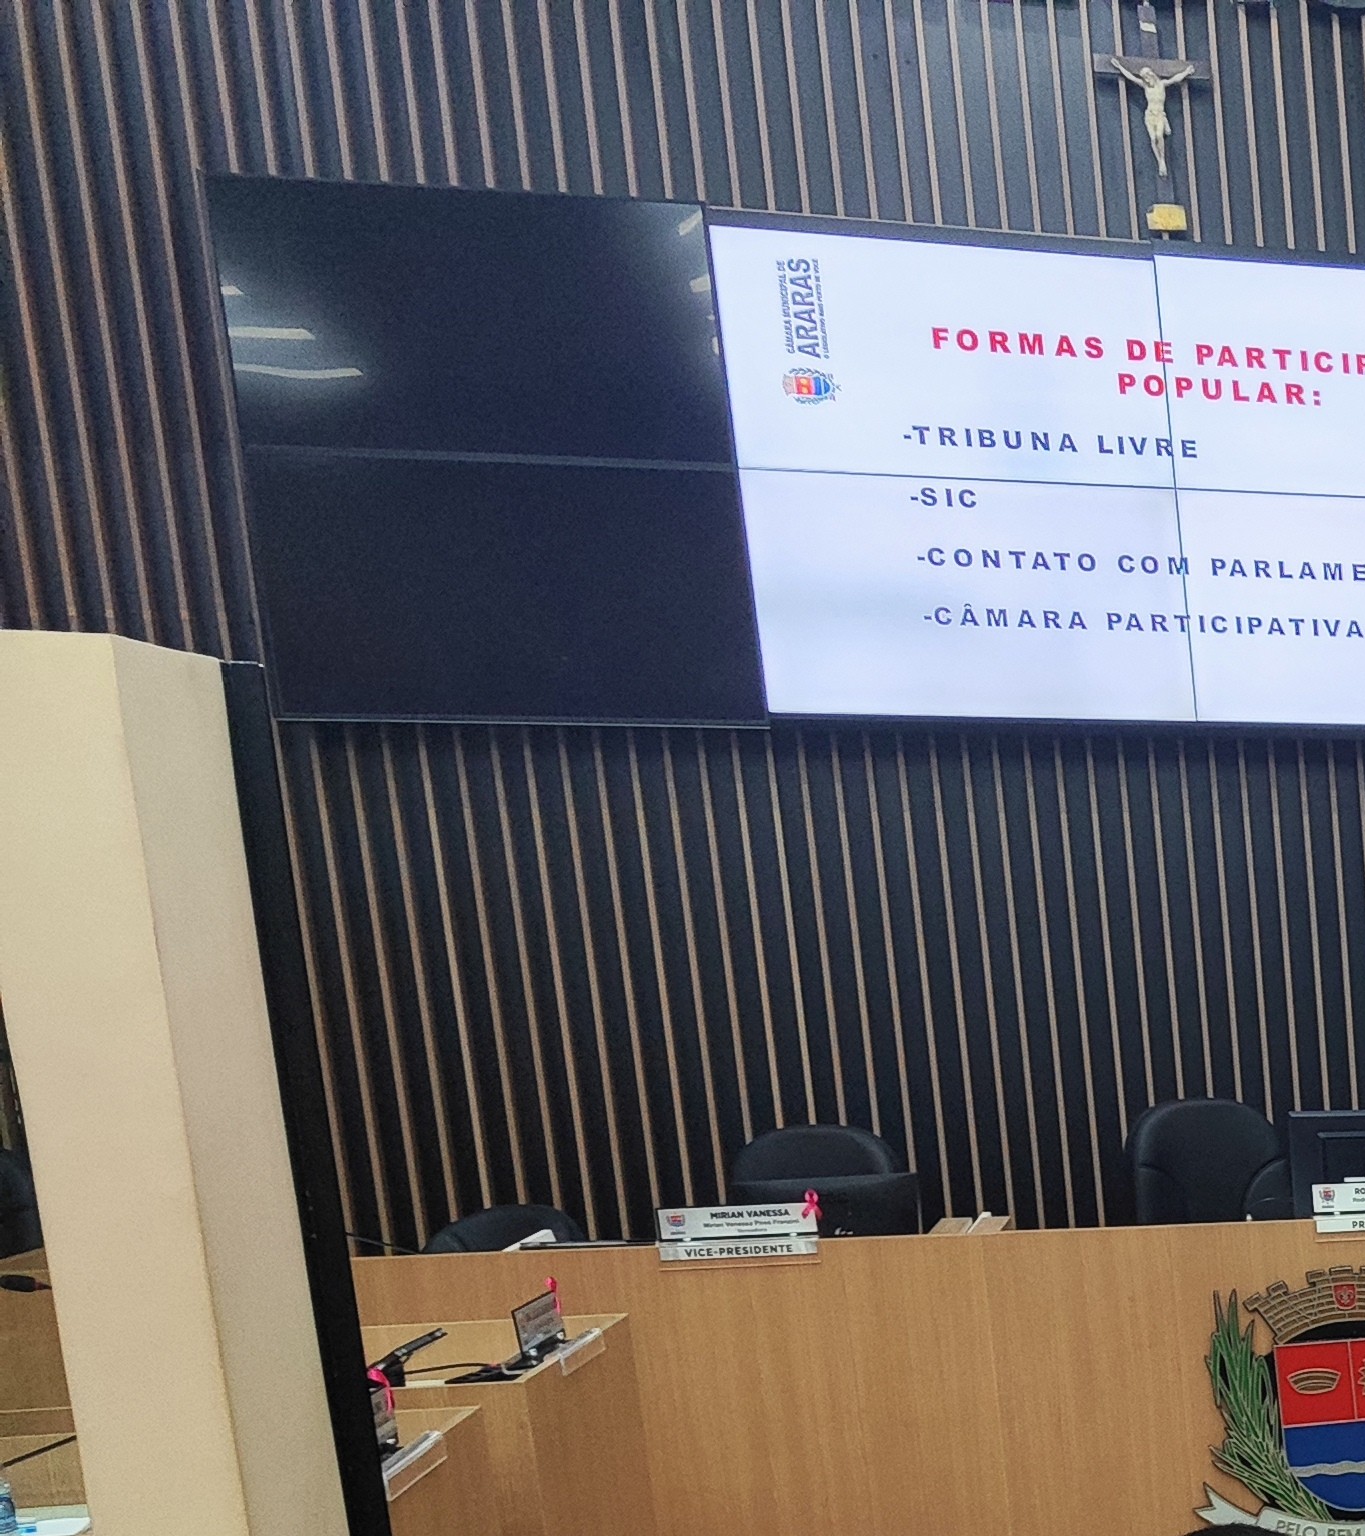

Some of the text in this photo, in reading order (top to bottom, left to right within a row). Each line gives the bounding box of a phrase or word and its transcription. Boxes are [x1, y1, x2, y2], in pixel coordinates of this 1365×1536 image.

[787, 258, 821, 359] ARARAS
[931, 327, 1105, 360] FORMAS
[1126, 339, 1174, 363] DE
[1117, 372, 1322, 407] POPULAR:
[1097, 434, 1198, 459] LIVRE
[1117, 555, 1190, 576] COM
[1106, 612, 1364, 639] PARTICIPATIVA
[710, 1208, 791, 1220] MIRIAN VANESSA
[684, 1244, 793, 1258] VICE-PRESIDENTE
